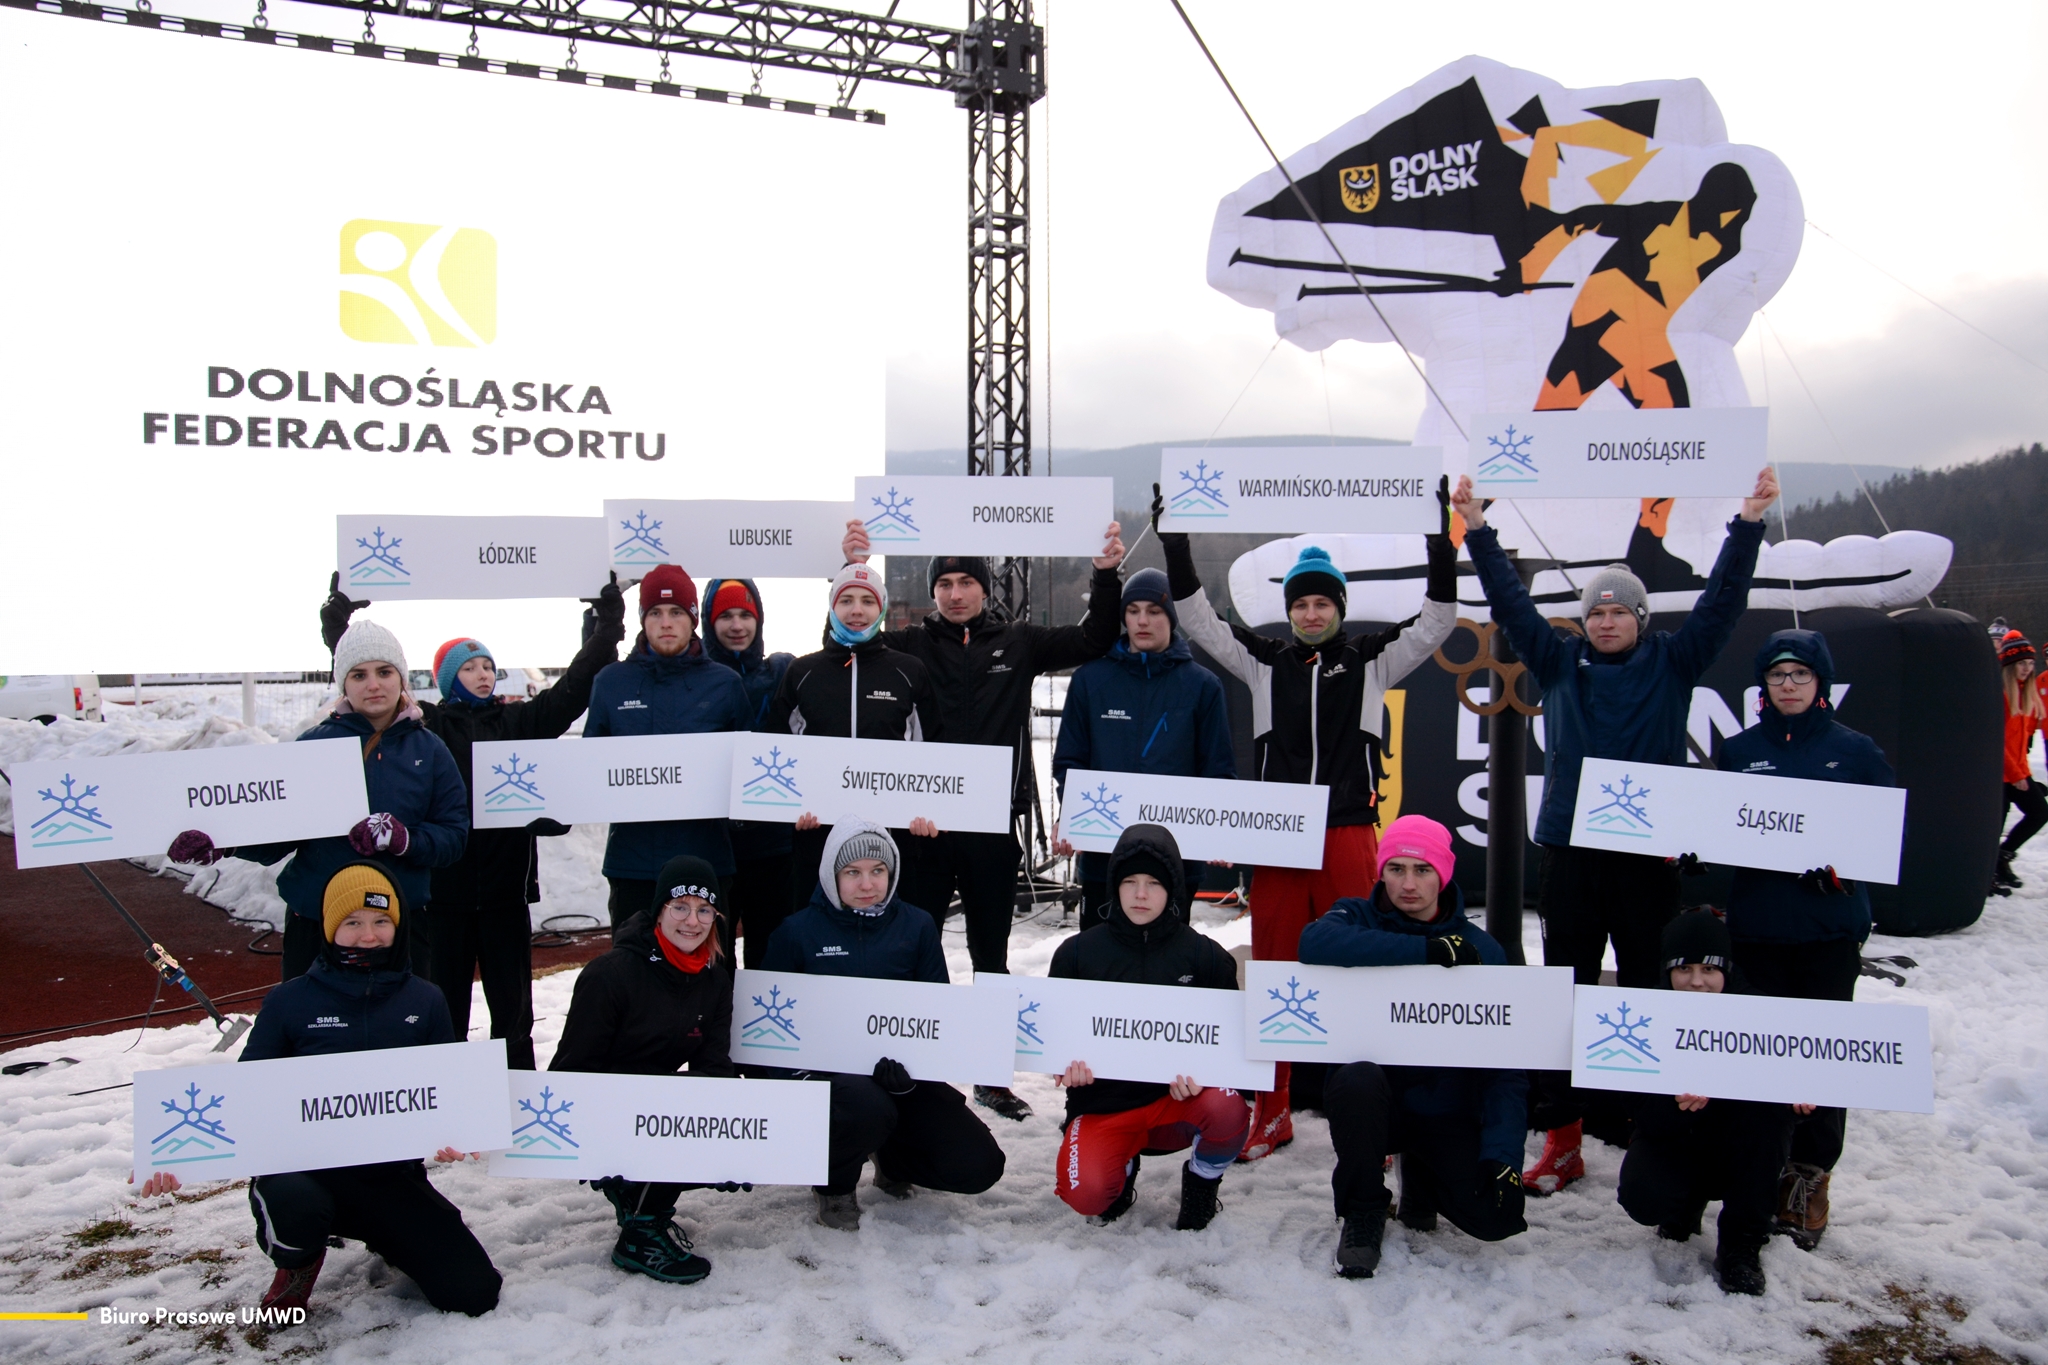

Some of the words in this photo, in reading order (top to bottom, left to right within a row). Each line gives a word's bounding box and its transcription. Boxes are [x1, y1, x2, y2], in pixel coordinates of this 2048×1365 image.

[1389, 139, 1483, 180] DOLNY
[1391, 164, 1479, 202] ŚLĄSK
[206, 366, 612, 418] DOLNOŚLĄSKA
[143, 412, 451, 454] FEDERACJA
[471, 415, 666, 462] SPORTU
[1587, 437, 1706, 466] DOLNOŚLĄSKIE
[1238, 474, 1424, 499] WARMIŃSKO-MAZURSKIE
[973, 505, 1054, 524] POMORSKIE
[729, 528, 793, 546] LUBUSKIE
[478, 541, 537, 565] ŁÓDZKIE
[608, 765, 683, 788] LUBELSKIE
[1750, 760, 1769, 768] SMS
[187, 779, 287, 809] PODLASKIE
[841, 765, 965, 796] ŚWIĘTOKRZYSKIE
[1138, 803, 1306, 833] KUJAWSKO-POMORSKIE
[1736, 802, 1805, 836] ŚLĄSKIE
[822, 945, 842, 953] SMS
[1178, 975, 1194, 984] 4F
[316, 1016, 340, 1024] SMS
[405, 1014, 420, 1024] 4F
[866, 1014, 940, 1041] OPOLSKIE
[1390, 1002, 1512, 1027] MAŁOPOLSKIE
[1092, 1016, 1220, 1046] WIELKOPOLSKIE
[1675, 1028, 1903, 1066] ZACHODNIOPOMORSKIE
[301, 1086, 438, 1123] MAZOWIECKIE
[635, 1114, 768, 1140] PODKARPACKIE
[1067, 1143, 1081, 1190] PORĘBA
